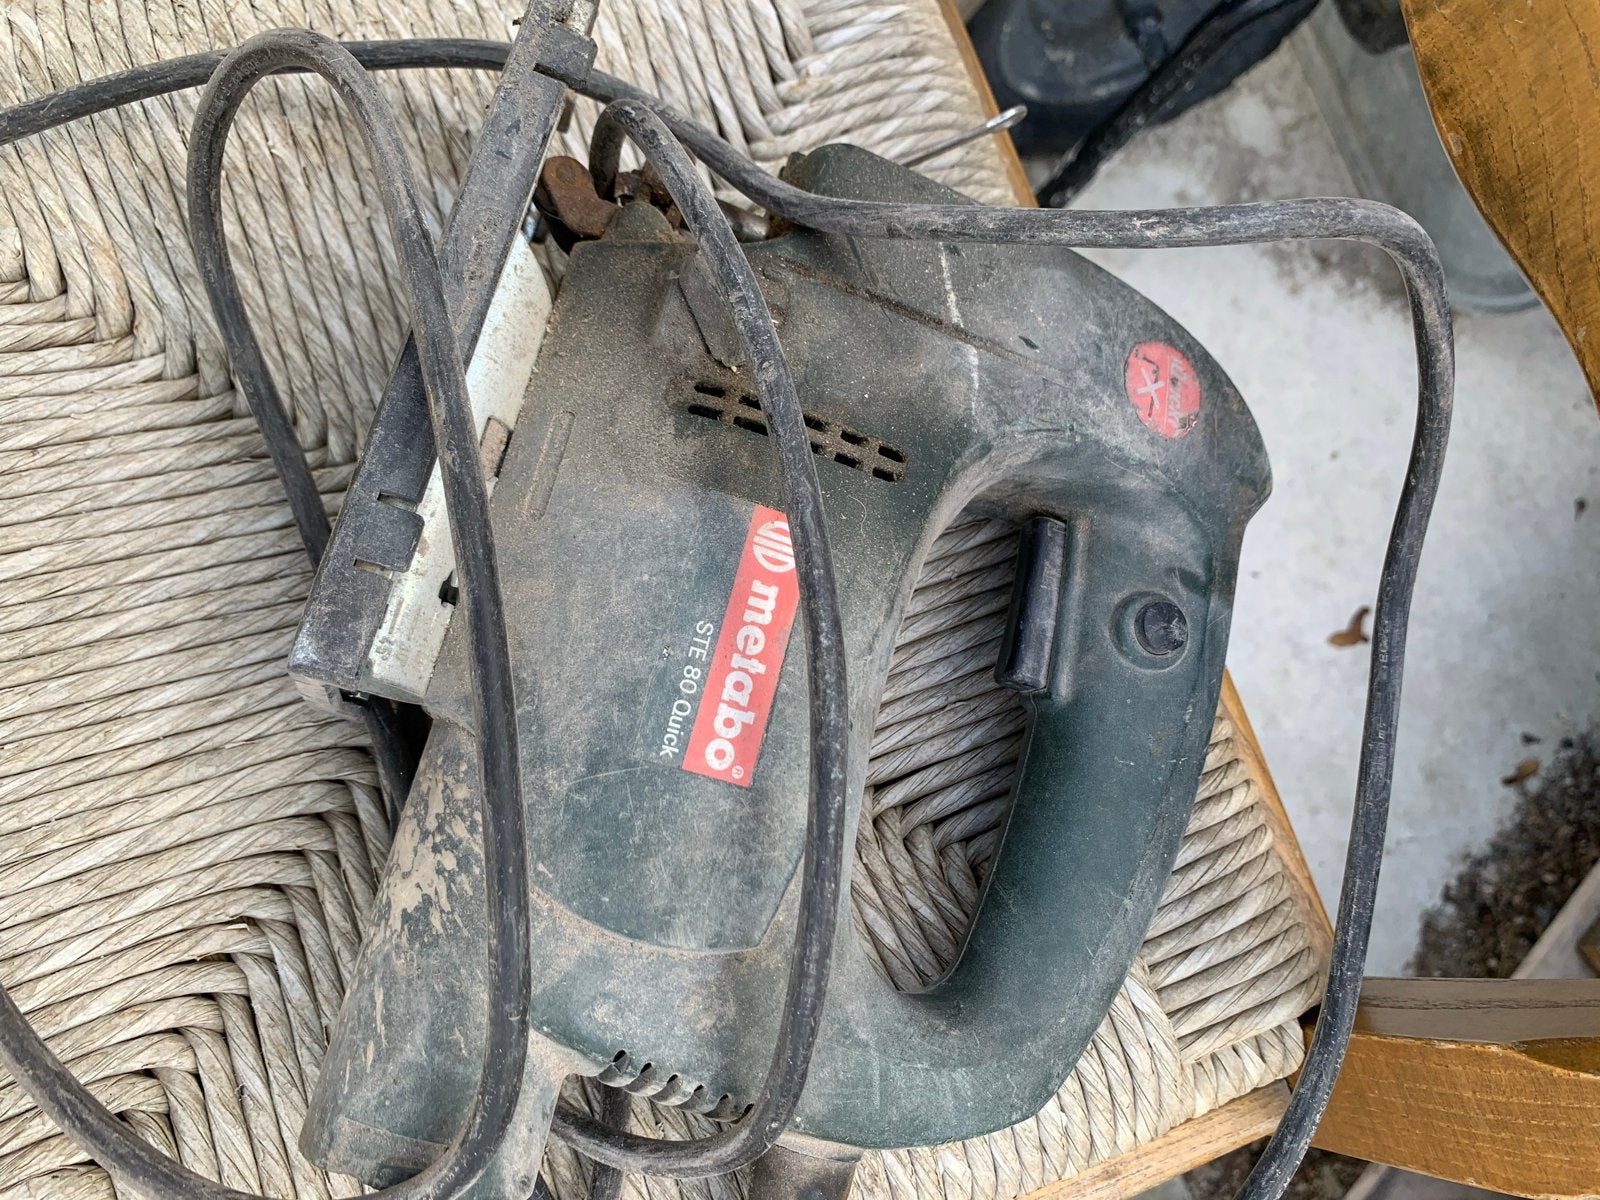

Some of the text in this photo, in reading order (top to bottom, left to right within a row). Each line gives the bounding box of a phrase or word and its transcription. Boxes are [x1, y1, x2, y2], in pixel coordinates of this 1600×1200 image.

[659, 620, 714, 757] STE 80 Quick
[704, 579, 779, 771] metabo
